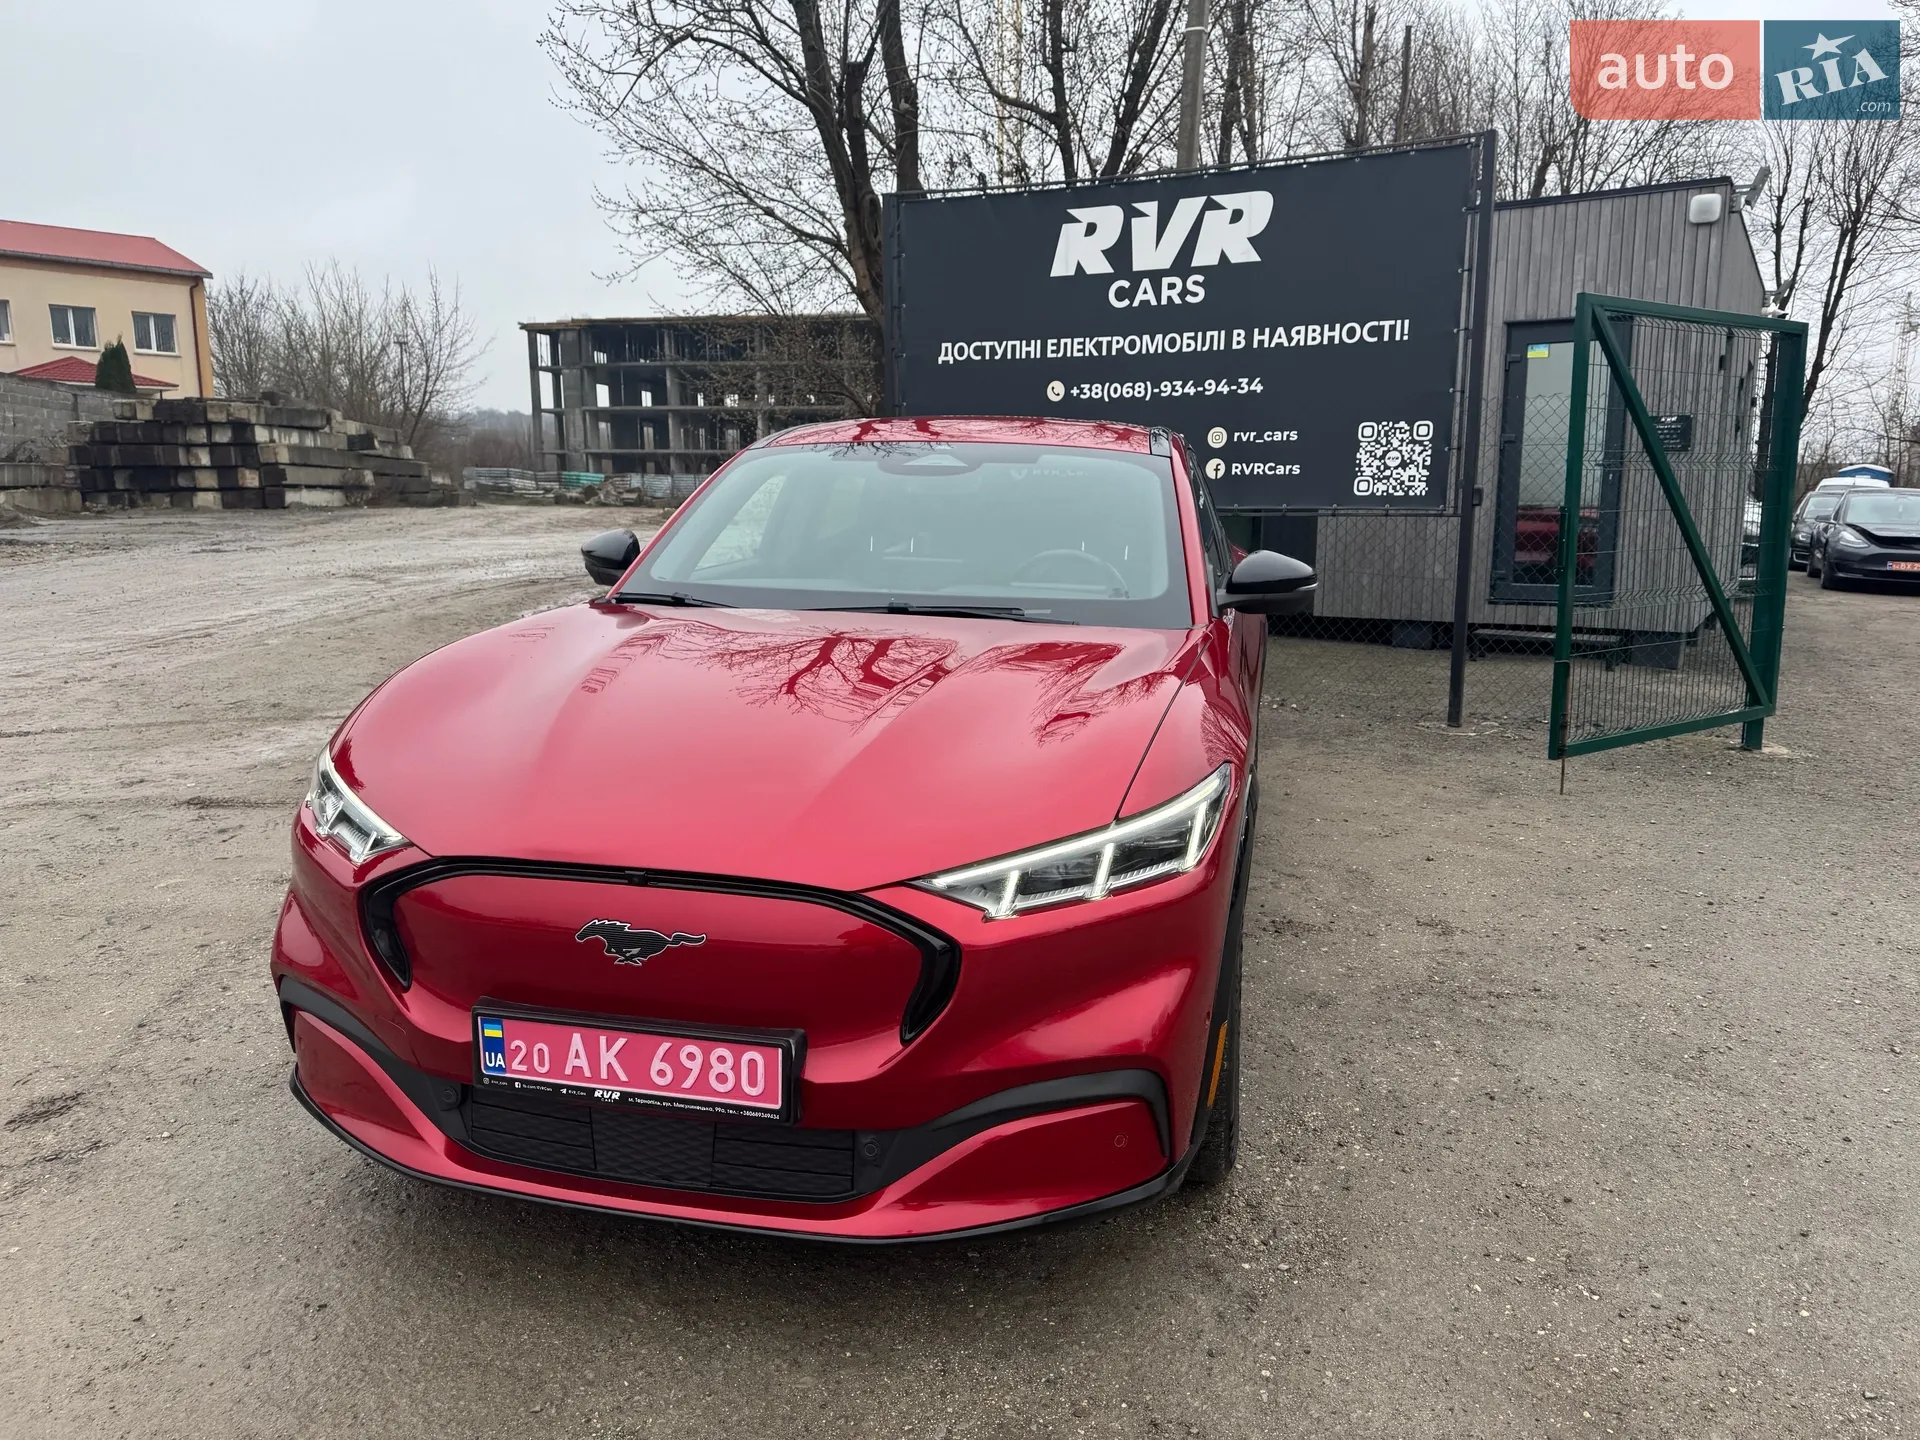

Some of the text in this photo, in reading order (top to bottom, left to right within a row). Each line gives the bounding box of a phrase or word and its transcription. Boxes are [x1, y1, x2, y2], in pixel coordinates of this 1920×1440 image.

[1050, 190, 1274, 277] RVR
[1108, 274, 1206, 308] CARS
[937, 319, 1410, 365] ДОСТУПНІ ЕЛЕКТРОМОБІЛІ В НАЯВНОСТІ!
[1070, 377, 1264, 402] +38(068)-934-94-34
[1233, 430, 1298, 443] rvr_cars
[1231, 462, 1301, 476] RVRCars
[485, 1051, 506, 1069] UA
[509, 1032, 766, 1096] 20 AK 6980
[594, 1089, 621, 1100] RVR
